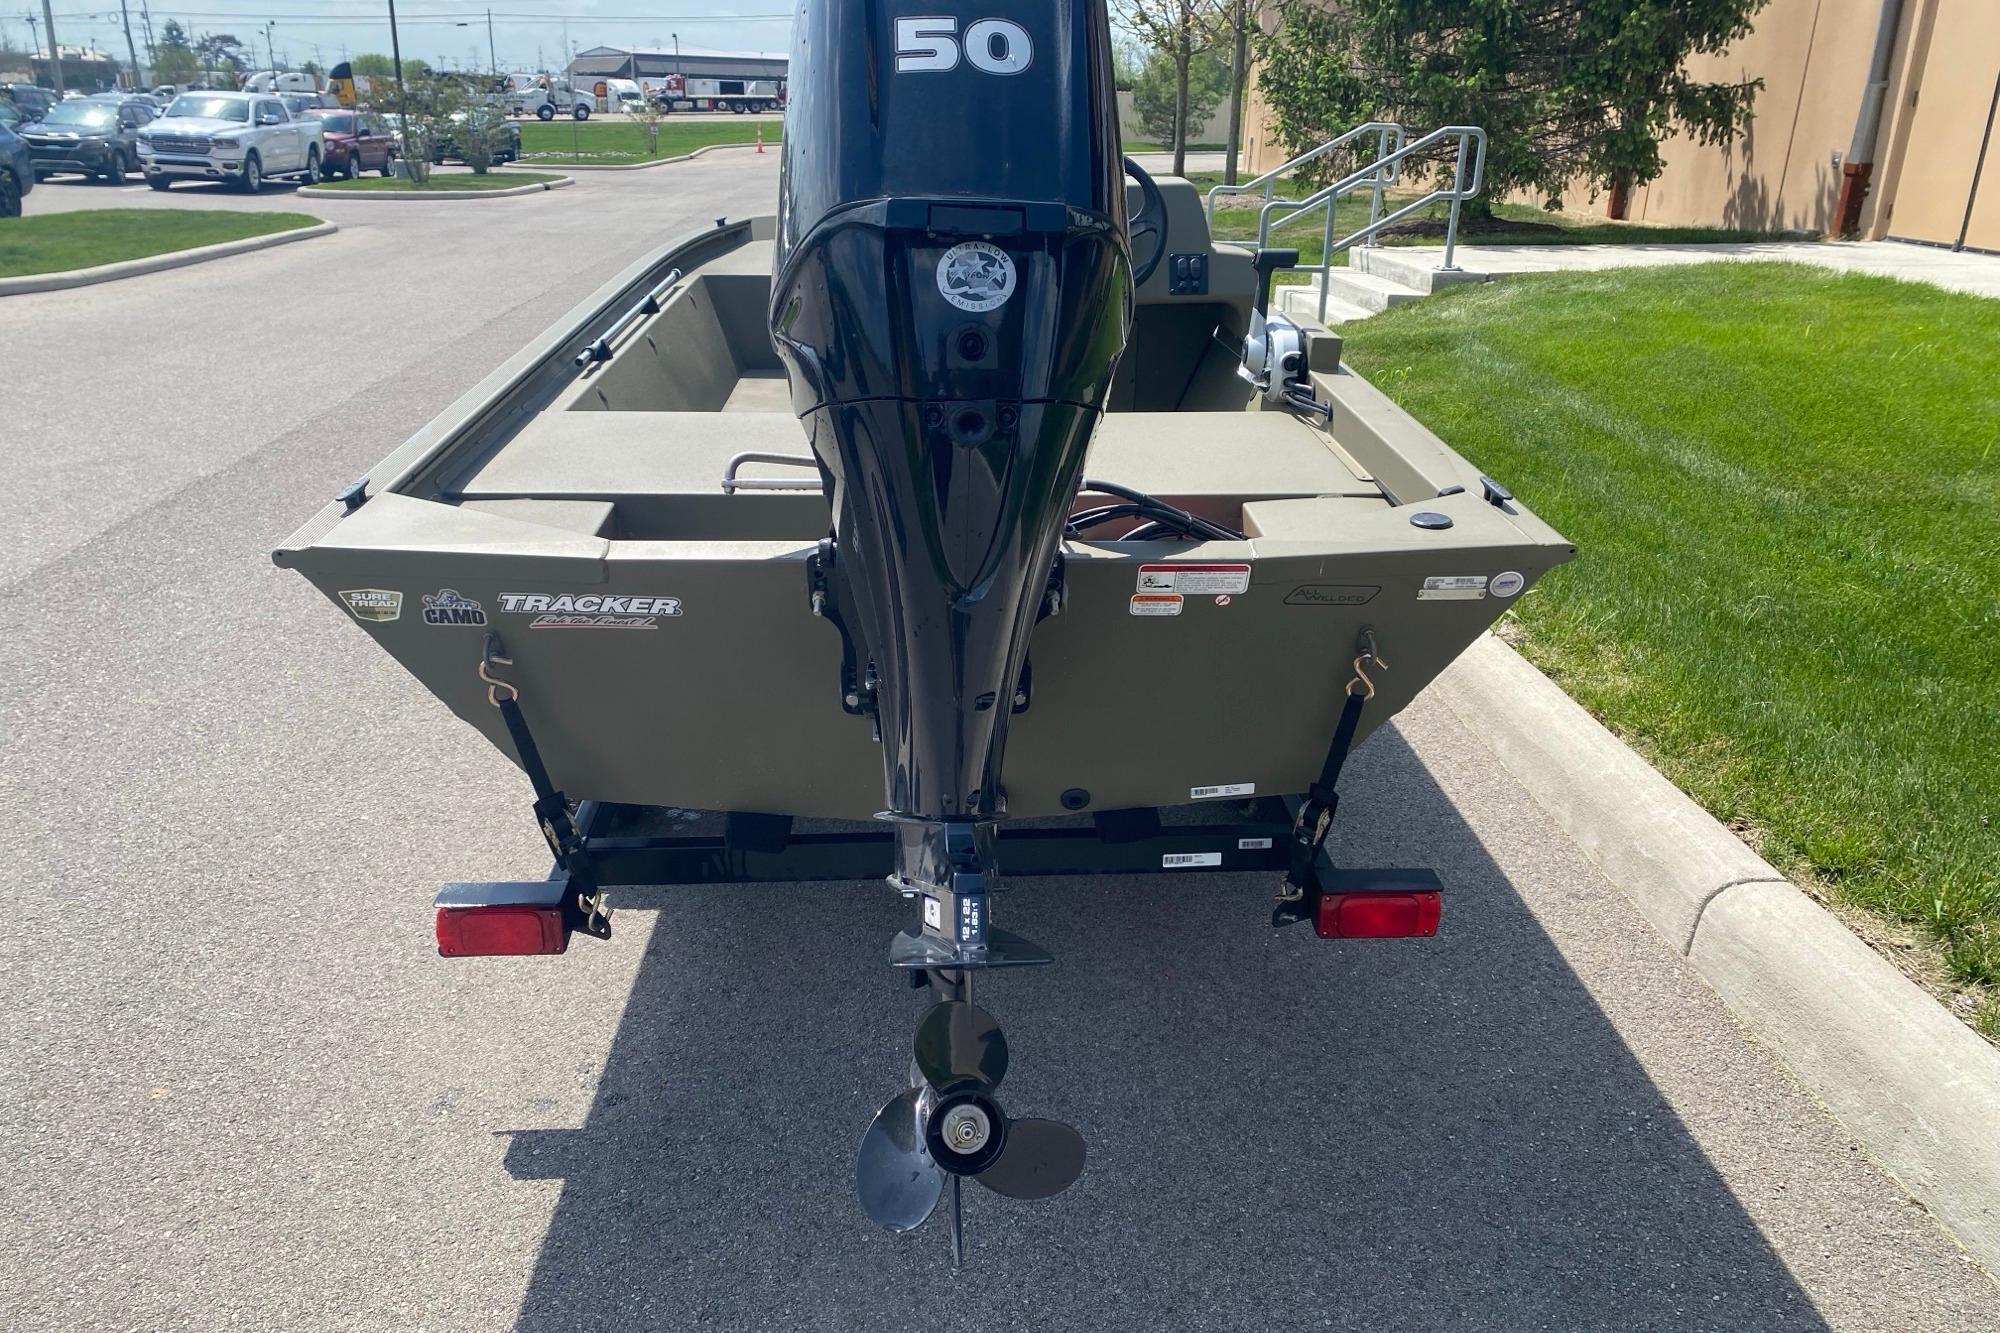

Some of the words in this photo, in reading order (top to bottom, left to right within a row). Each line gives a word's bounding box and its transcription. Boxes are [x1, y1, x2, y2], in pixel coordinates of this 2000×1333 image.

[894, 16, 1034, 76] 50
[350, 593, 391, 601] SURE
[499, 594, 681, 615] TRACKER
[425, 608, 486, 625] CAMO
[963, 898, 971, 915] 22
[962, 926, 970, 941] 12
